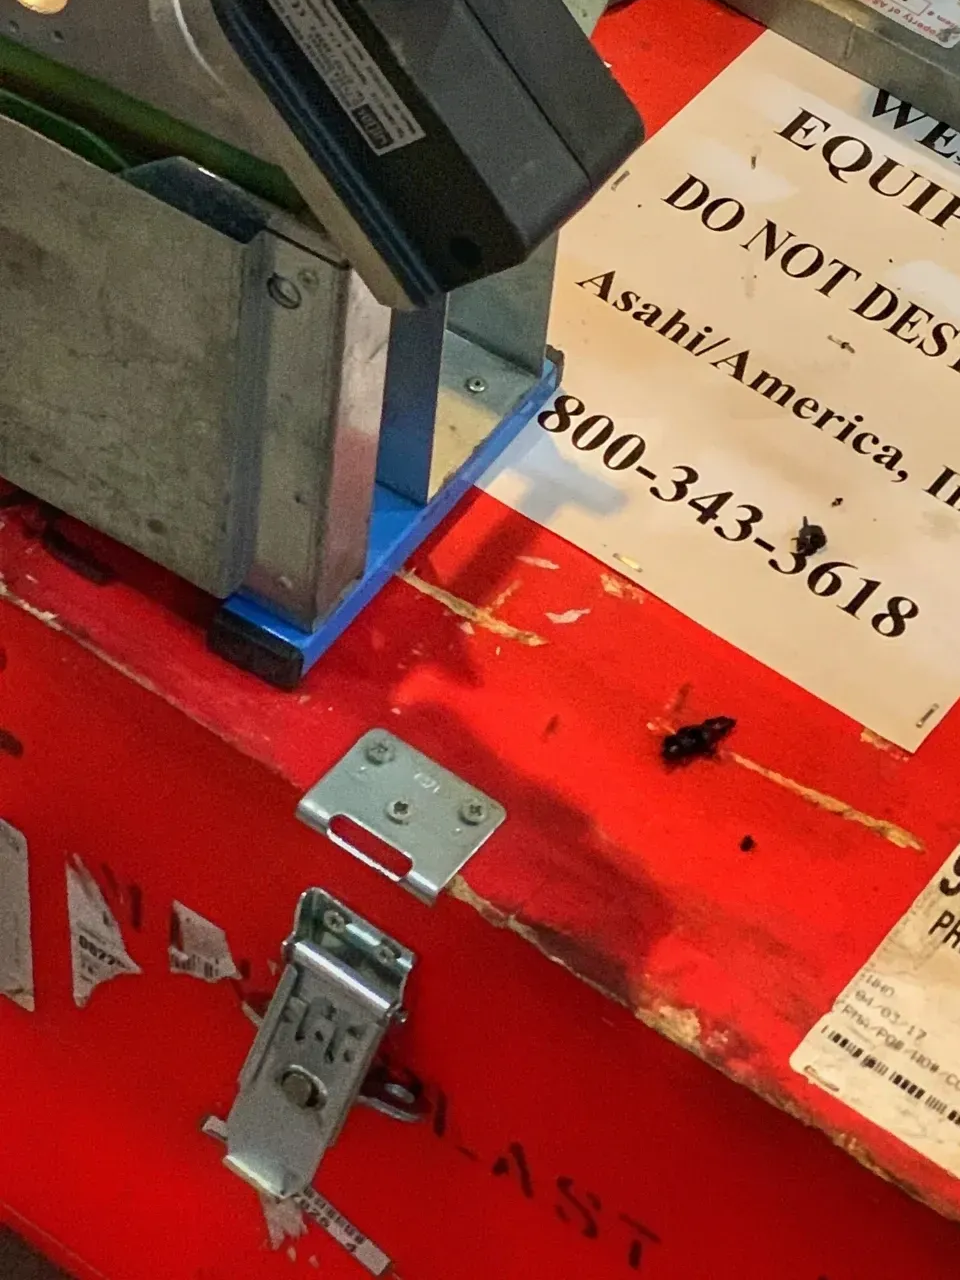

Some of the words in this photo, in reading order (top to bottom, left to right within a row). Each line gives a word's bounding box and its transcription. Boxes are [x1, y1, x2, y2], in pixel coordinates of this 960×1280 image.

[661, 173, 745, 233] DO
[739, 219, 862, 298] NOT
[575, 269, 909, 484] Asahi/America,
[537, 393, 920, 638] 800-343-3618
